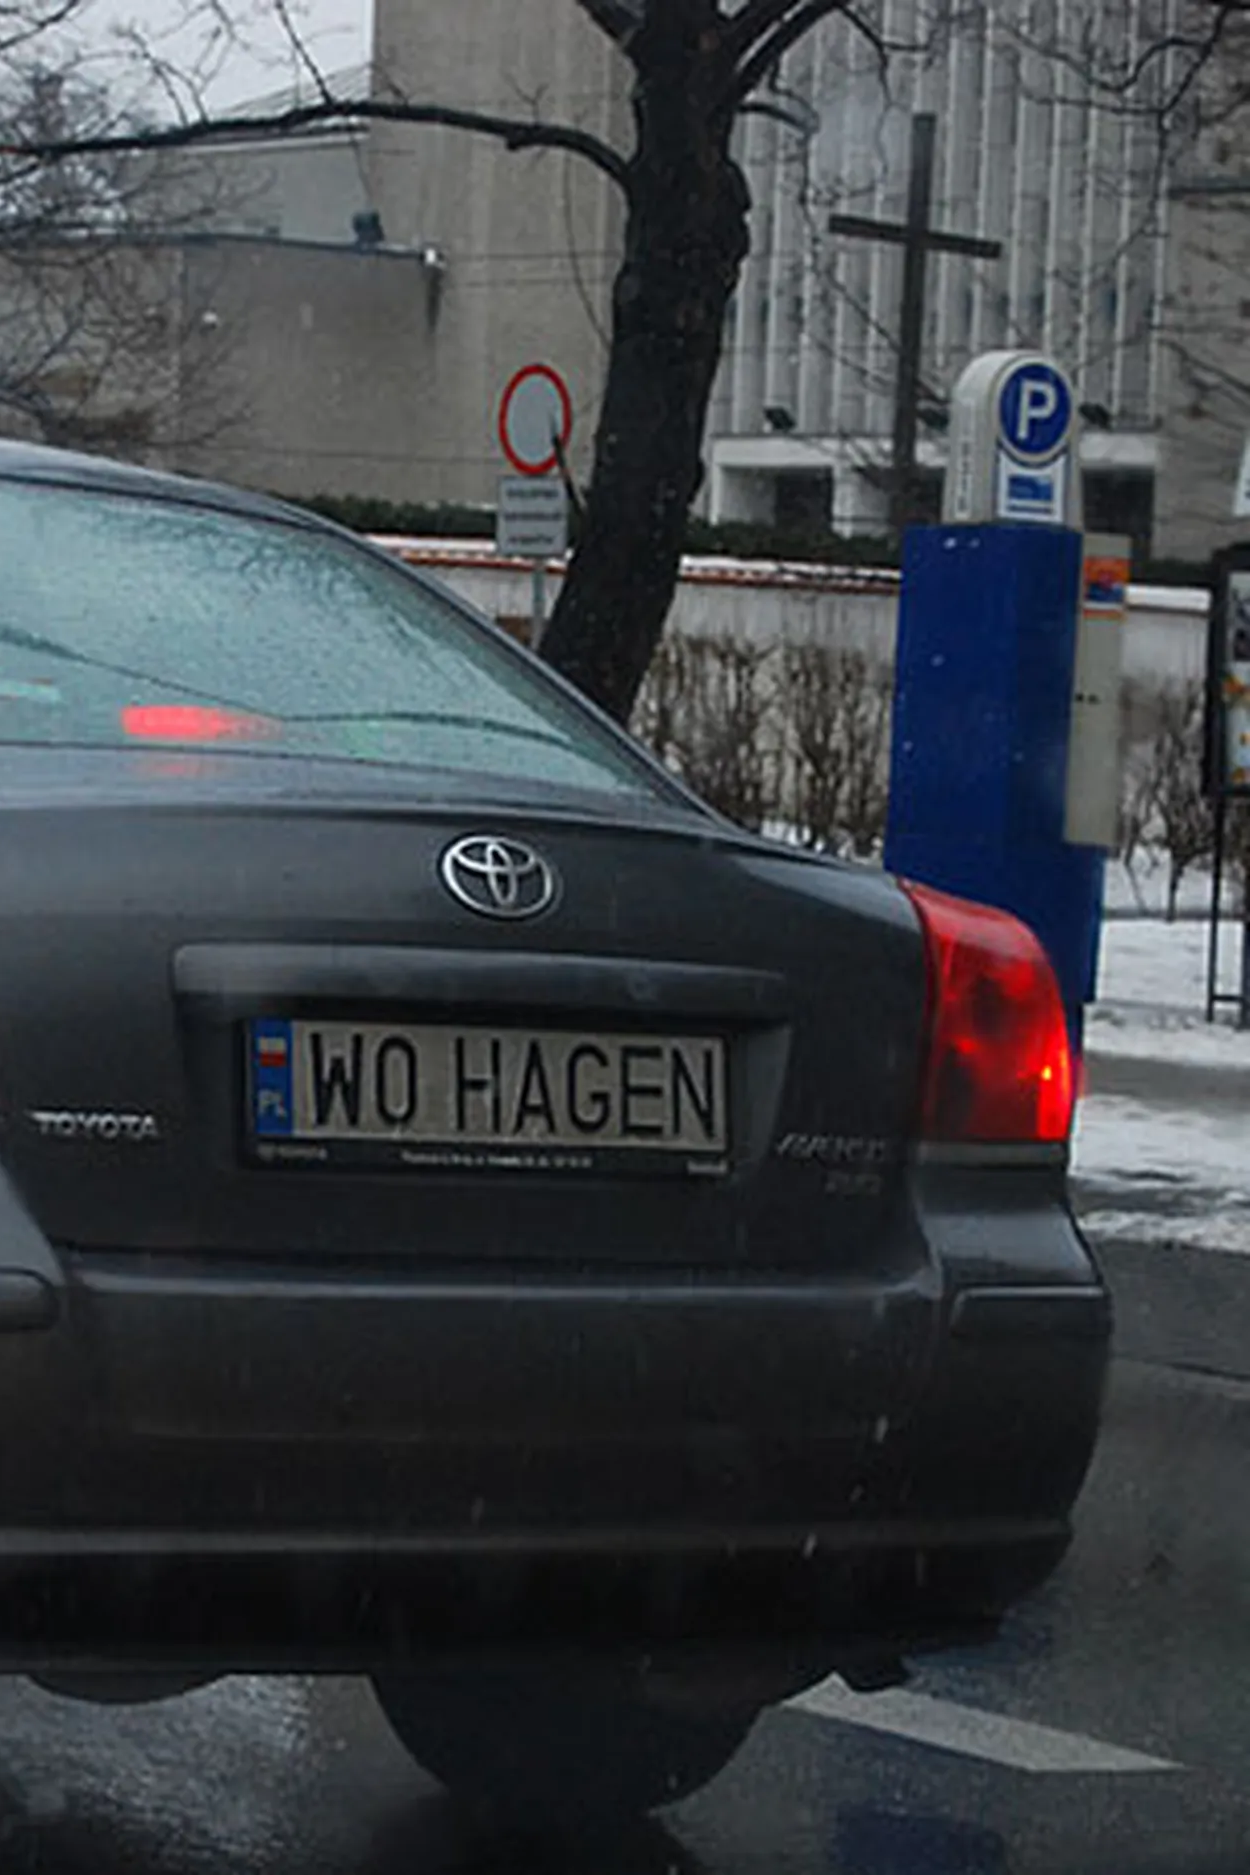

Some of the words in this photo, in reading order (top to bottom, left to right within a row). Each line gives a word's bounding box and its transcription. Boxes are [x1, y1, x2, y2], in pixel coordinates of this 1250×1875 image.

[1017, 378, 1058, 439] P
[455, 1036, 717, 1139] HAGEN
[32, 1111, 158, 1140] TOYOTA
